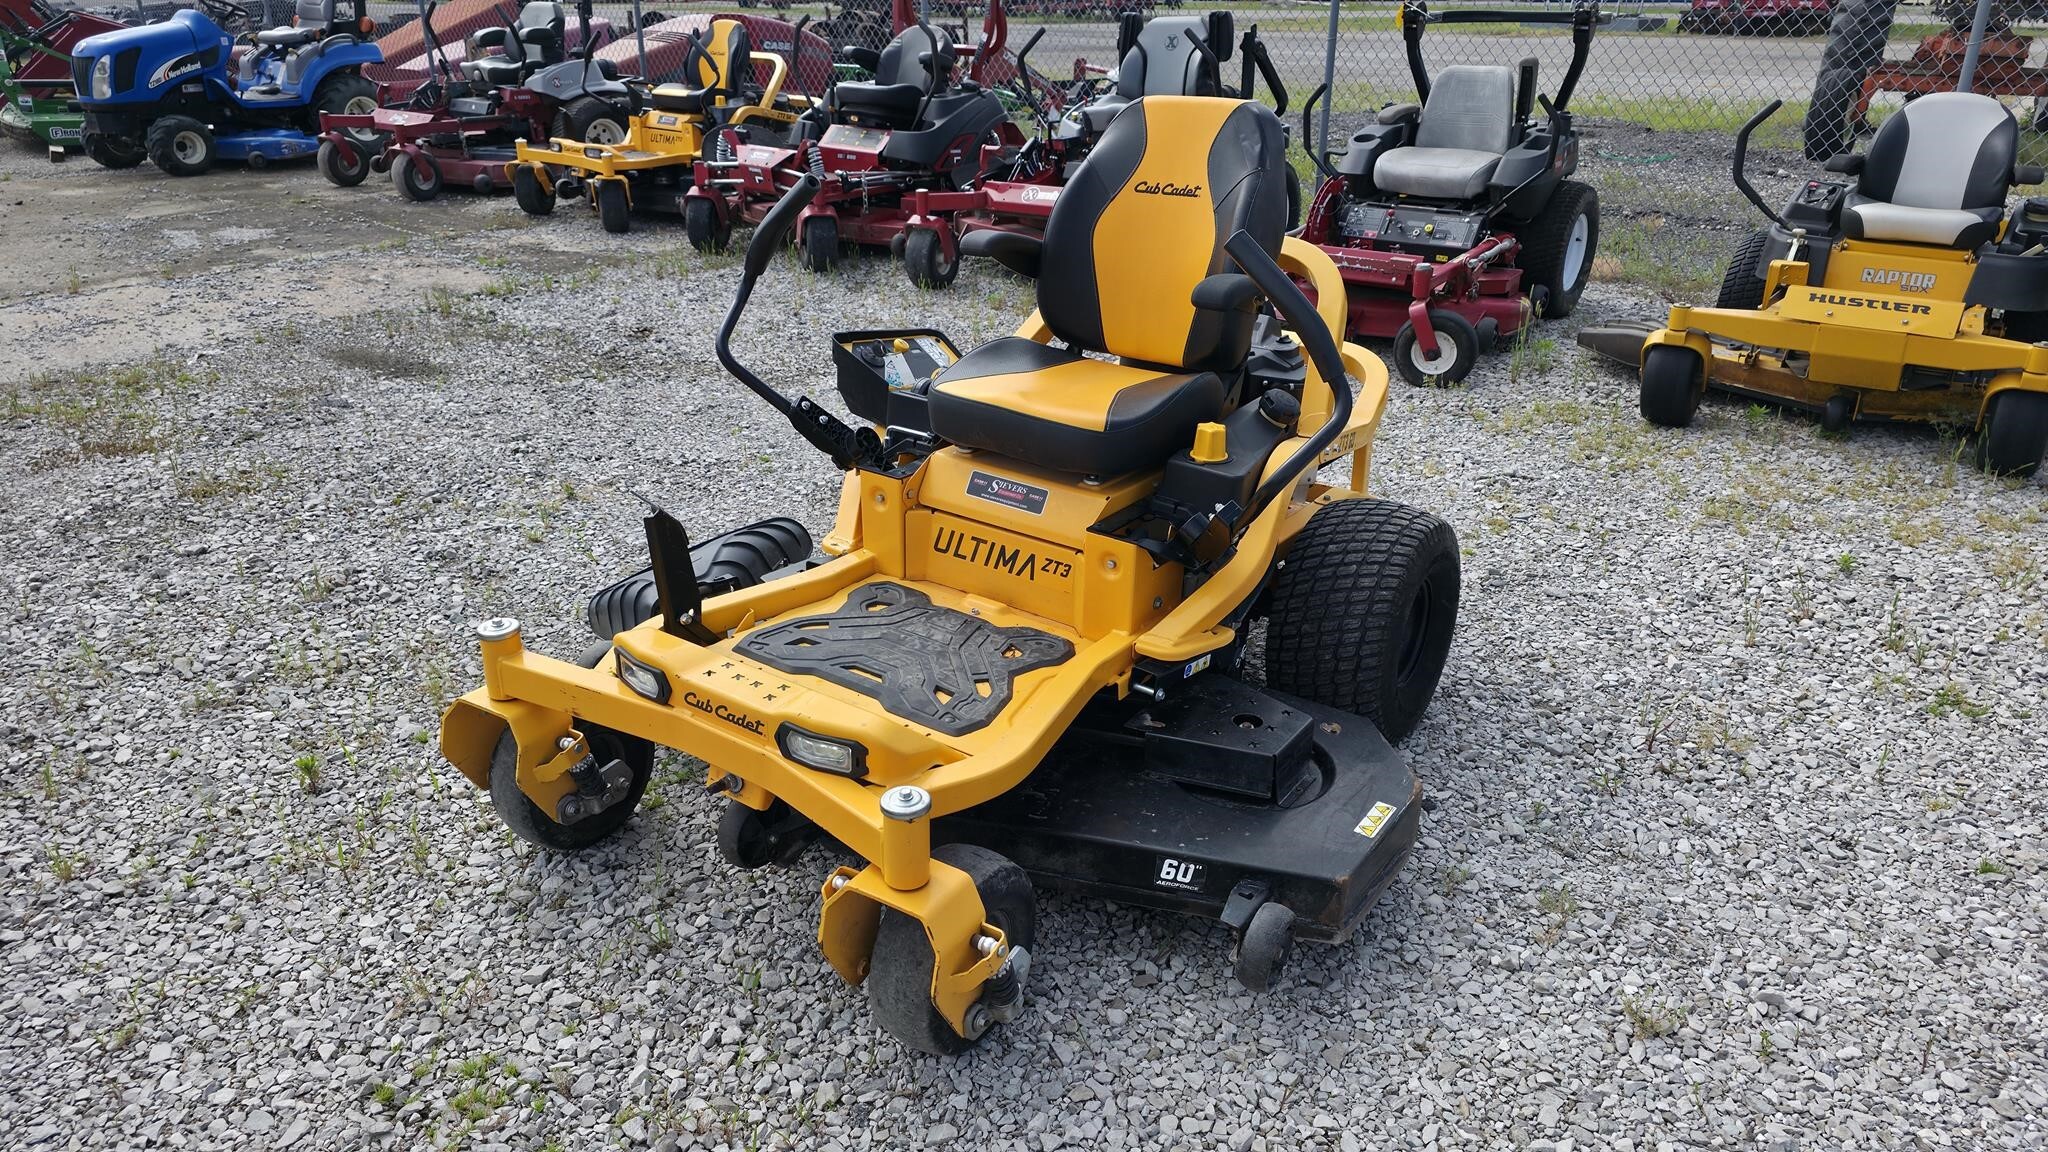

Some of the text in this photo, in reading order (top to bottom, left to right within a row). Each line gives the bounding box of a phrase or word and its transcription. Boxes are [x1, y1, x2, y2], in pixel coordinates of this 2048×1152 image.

[763, 41, 790, 50] CASE
[650, 133, 676, 145] ULTIMA
[1134, 181, 1202, 198] Cub Cadet
[1861, 268, 1937, 289] RAPTOR
[1809, 292, 1932, 316] HUSTLER
[987, 479, 1029, 494] SIEVERS
[933, 526, 1073, 581] ULTIMA ZT3
[684, 691, 766, 737] Cub Cadet
[1160, 858, 1203, 884] 60"
[1156, 880, 1200, 891] AEROFORCE
